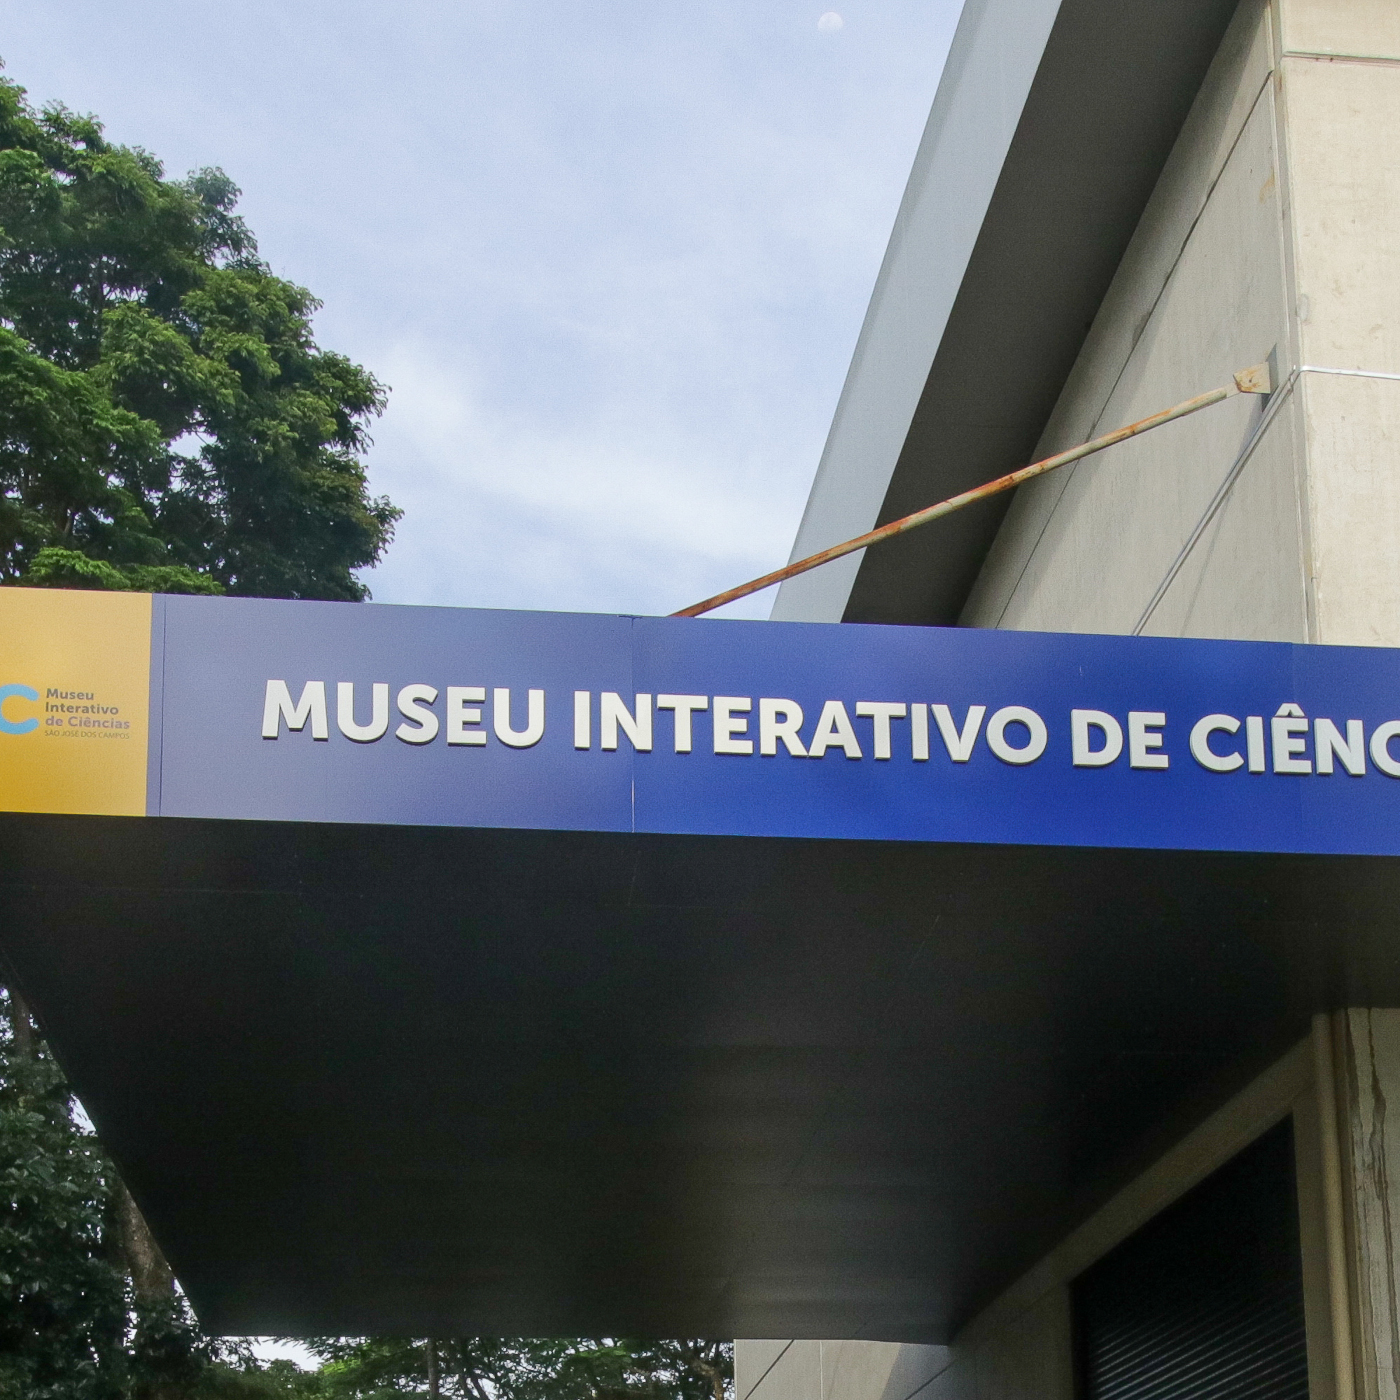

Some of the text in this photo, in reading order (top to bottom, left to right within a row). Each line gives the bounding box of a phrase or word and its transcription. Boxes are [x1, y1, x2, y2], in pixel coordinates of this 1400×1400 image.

[45, 688, 95, 701] Museu
[44, 701, 120, 715] Interativo
[44, 715, 131, 729] de Ciências
[261, 679, 546, 750] MUSEU
[574, 690, 1049, 767] INTERATIVO
[1070, 708, 1170, 771] DE
[81, 730, 97, 738] DOS
[98, 731, 130, 740] CAMPOS
